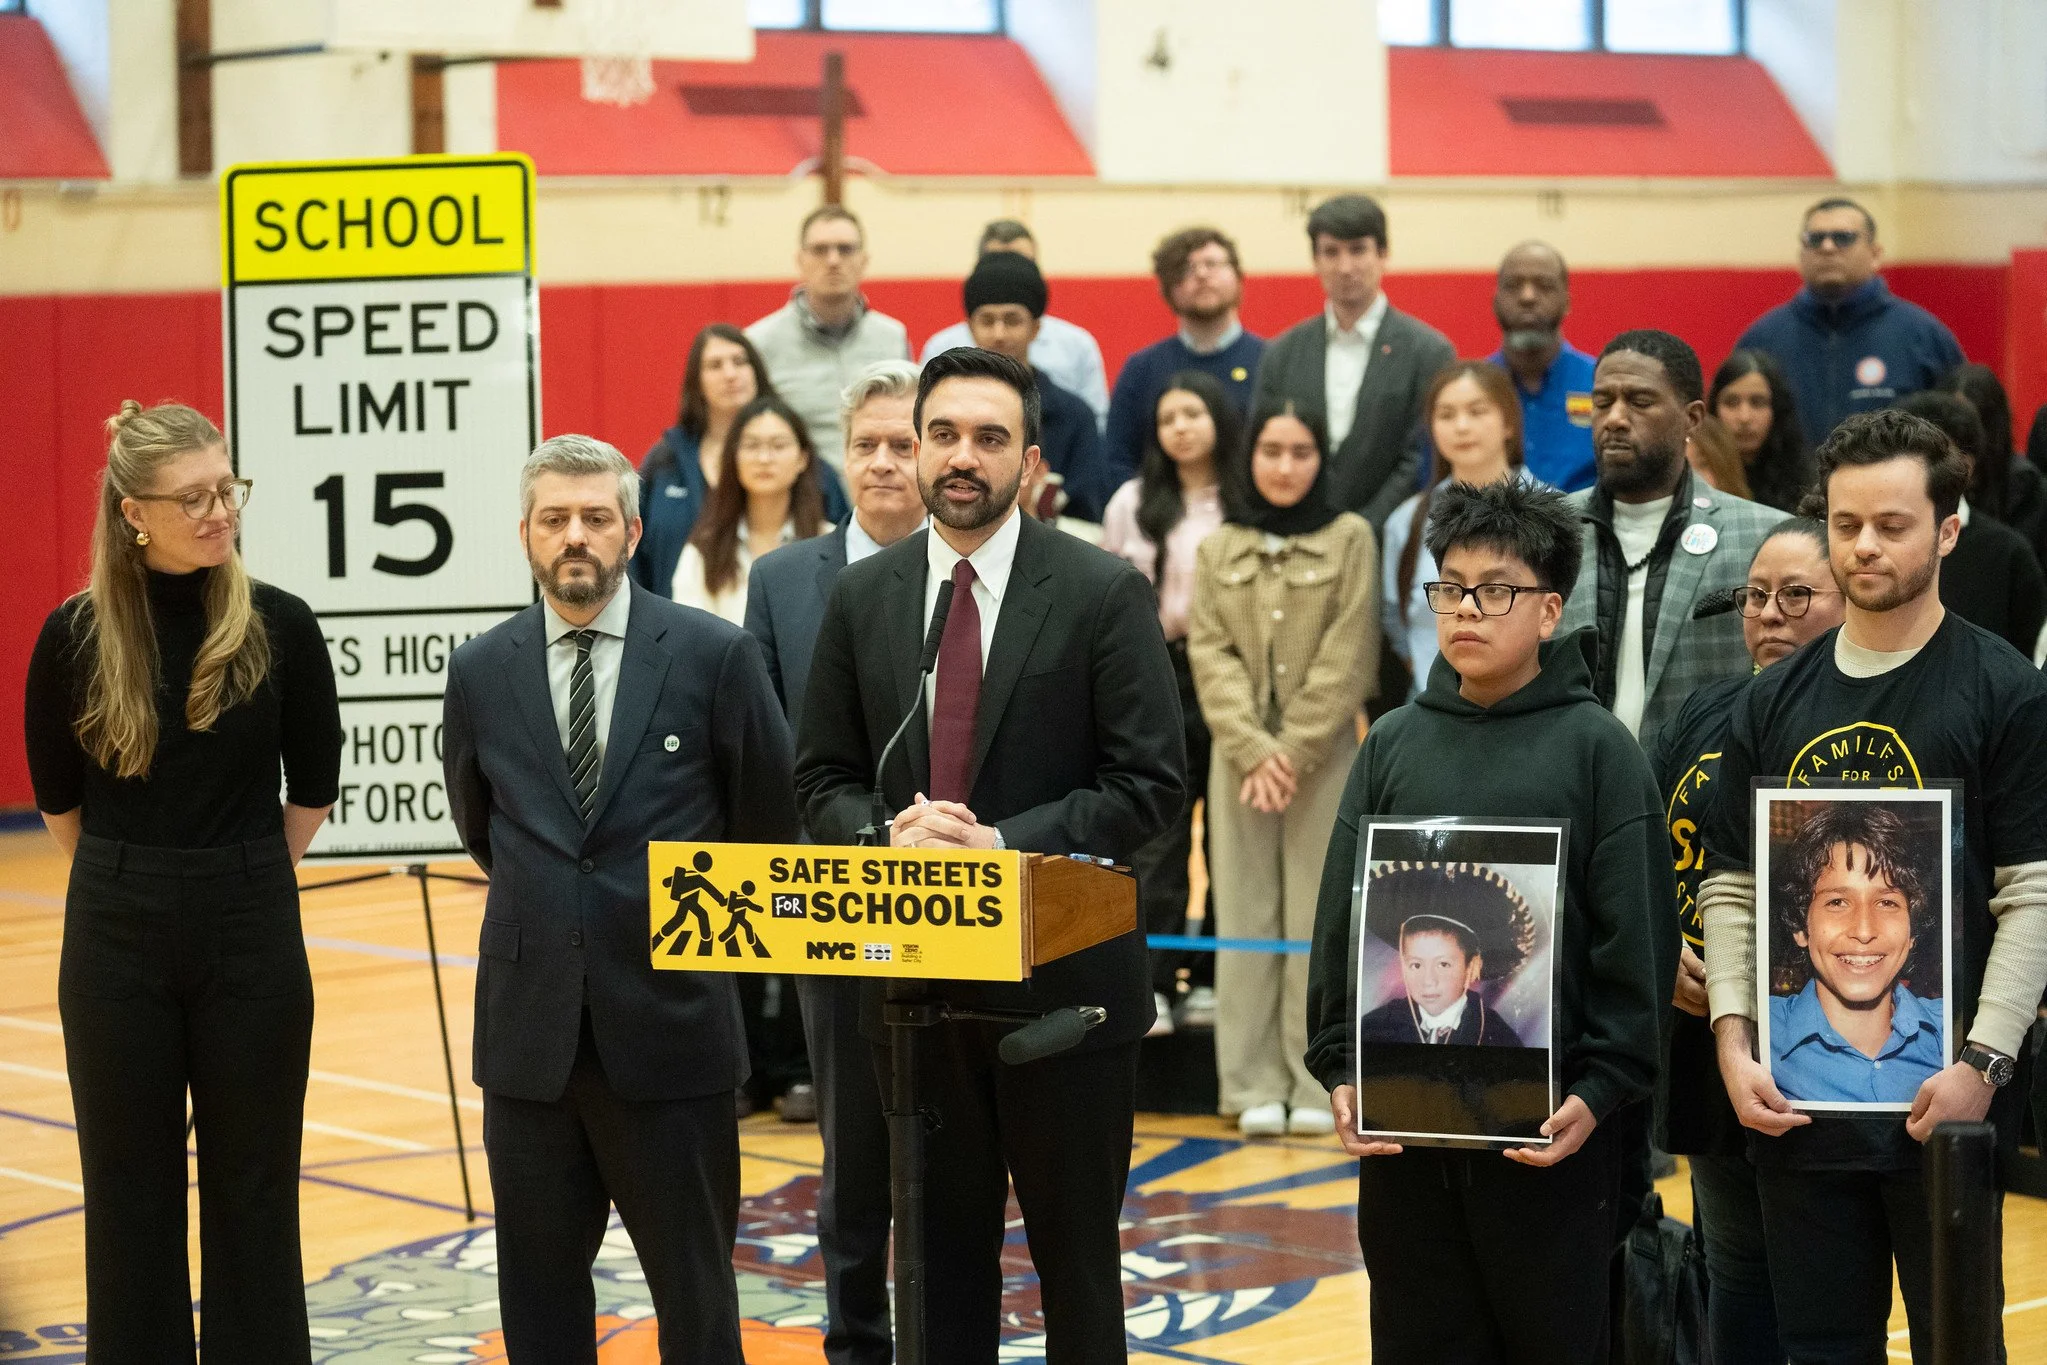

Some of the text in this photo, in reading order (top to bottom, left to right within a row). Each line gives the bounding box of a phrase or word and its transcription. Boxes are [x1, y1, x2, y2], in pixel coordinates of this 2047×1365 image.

[254, 194, 504, 252] SCHOOL
[264, 300, 499, 358] SPEED
[294, 379, 470, 435] LIMIT
[312, 471, 455, 578] 15
[1841, 770, 1871, 781] FOR
[769, 857, 1003, 888] SAFE STREETS
[775, 891, 1003, 928] FOR SCHOOLS
[806, 941, 856, 960] NYC
